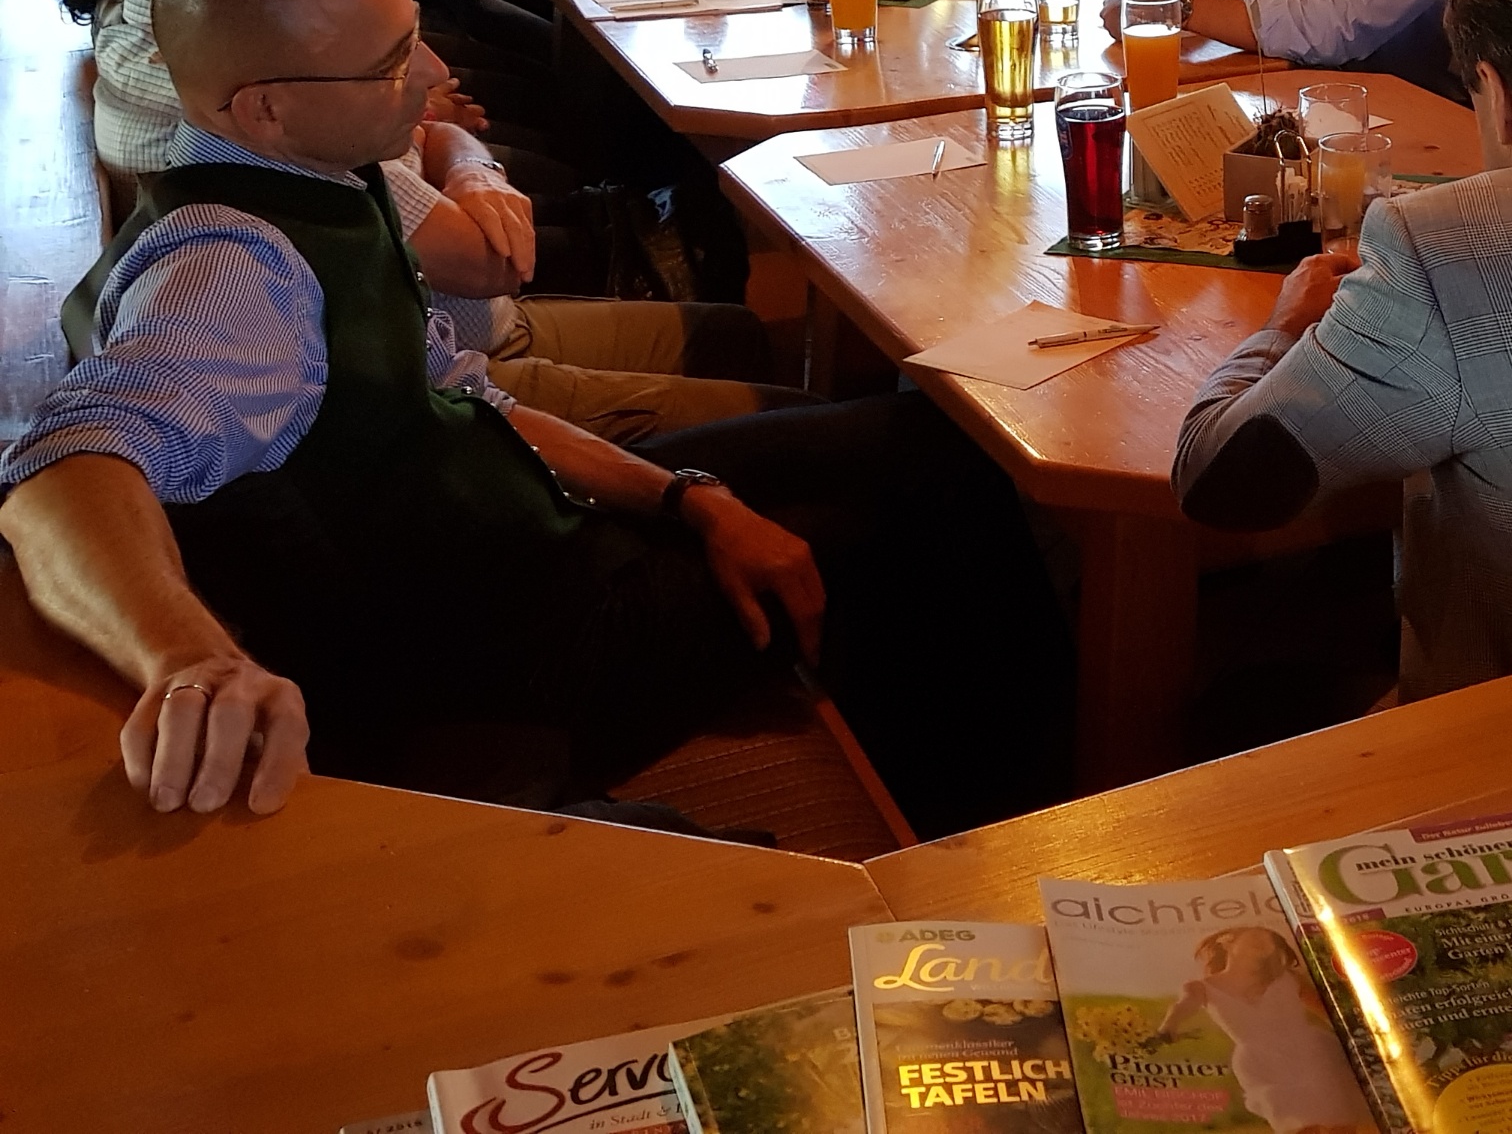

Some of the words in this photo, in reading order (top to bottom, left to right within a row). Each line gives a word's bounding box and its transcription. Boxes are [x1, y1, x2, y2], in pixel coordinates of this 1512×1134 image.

[1356, 852, 1416, 872] mein
[1405, 898, 1472, 913] EUROPAS
[899, 929, 976, 943] ADEG
[1434, 921, 1495, 937] Sichtschutz
[1441, 936, 1472, 950] Mit
[1473, 931, 1512, 946] einer
[1448, 944, 1504, 961] Garten
[873, 943, 1055, 992] Land
[1428, 979, 1491, 999] Top-Sorten
[1438, 1006, 1470, 1023] und
[898, 1058, 1072, 1087] FESTLICH
[1107, 1052, 1229, 1077] Pionier
[1110, 1072, 1181, 1089] GEIST
[901, 1080, 1048, 1109] TAFELN
[589, 1119, 606, 1130] in
[610, 1111, 651, 1127] Stadt
